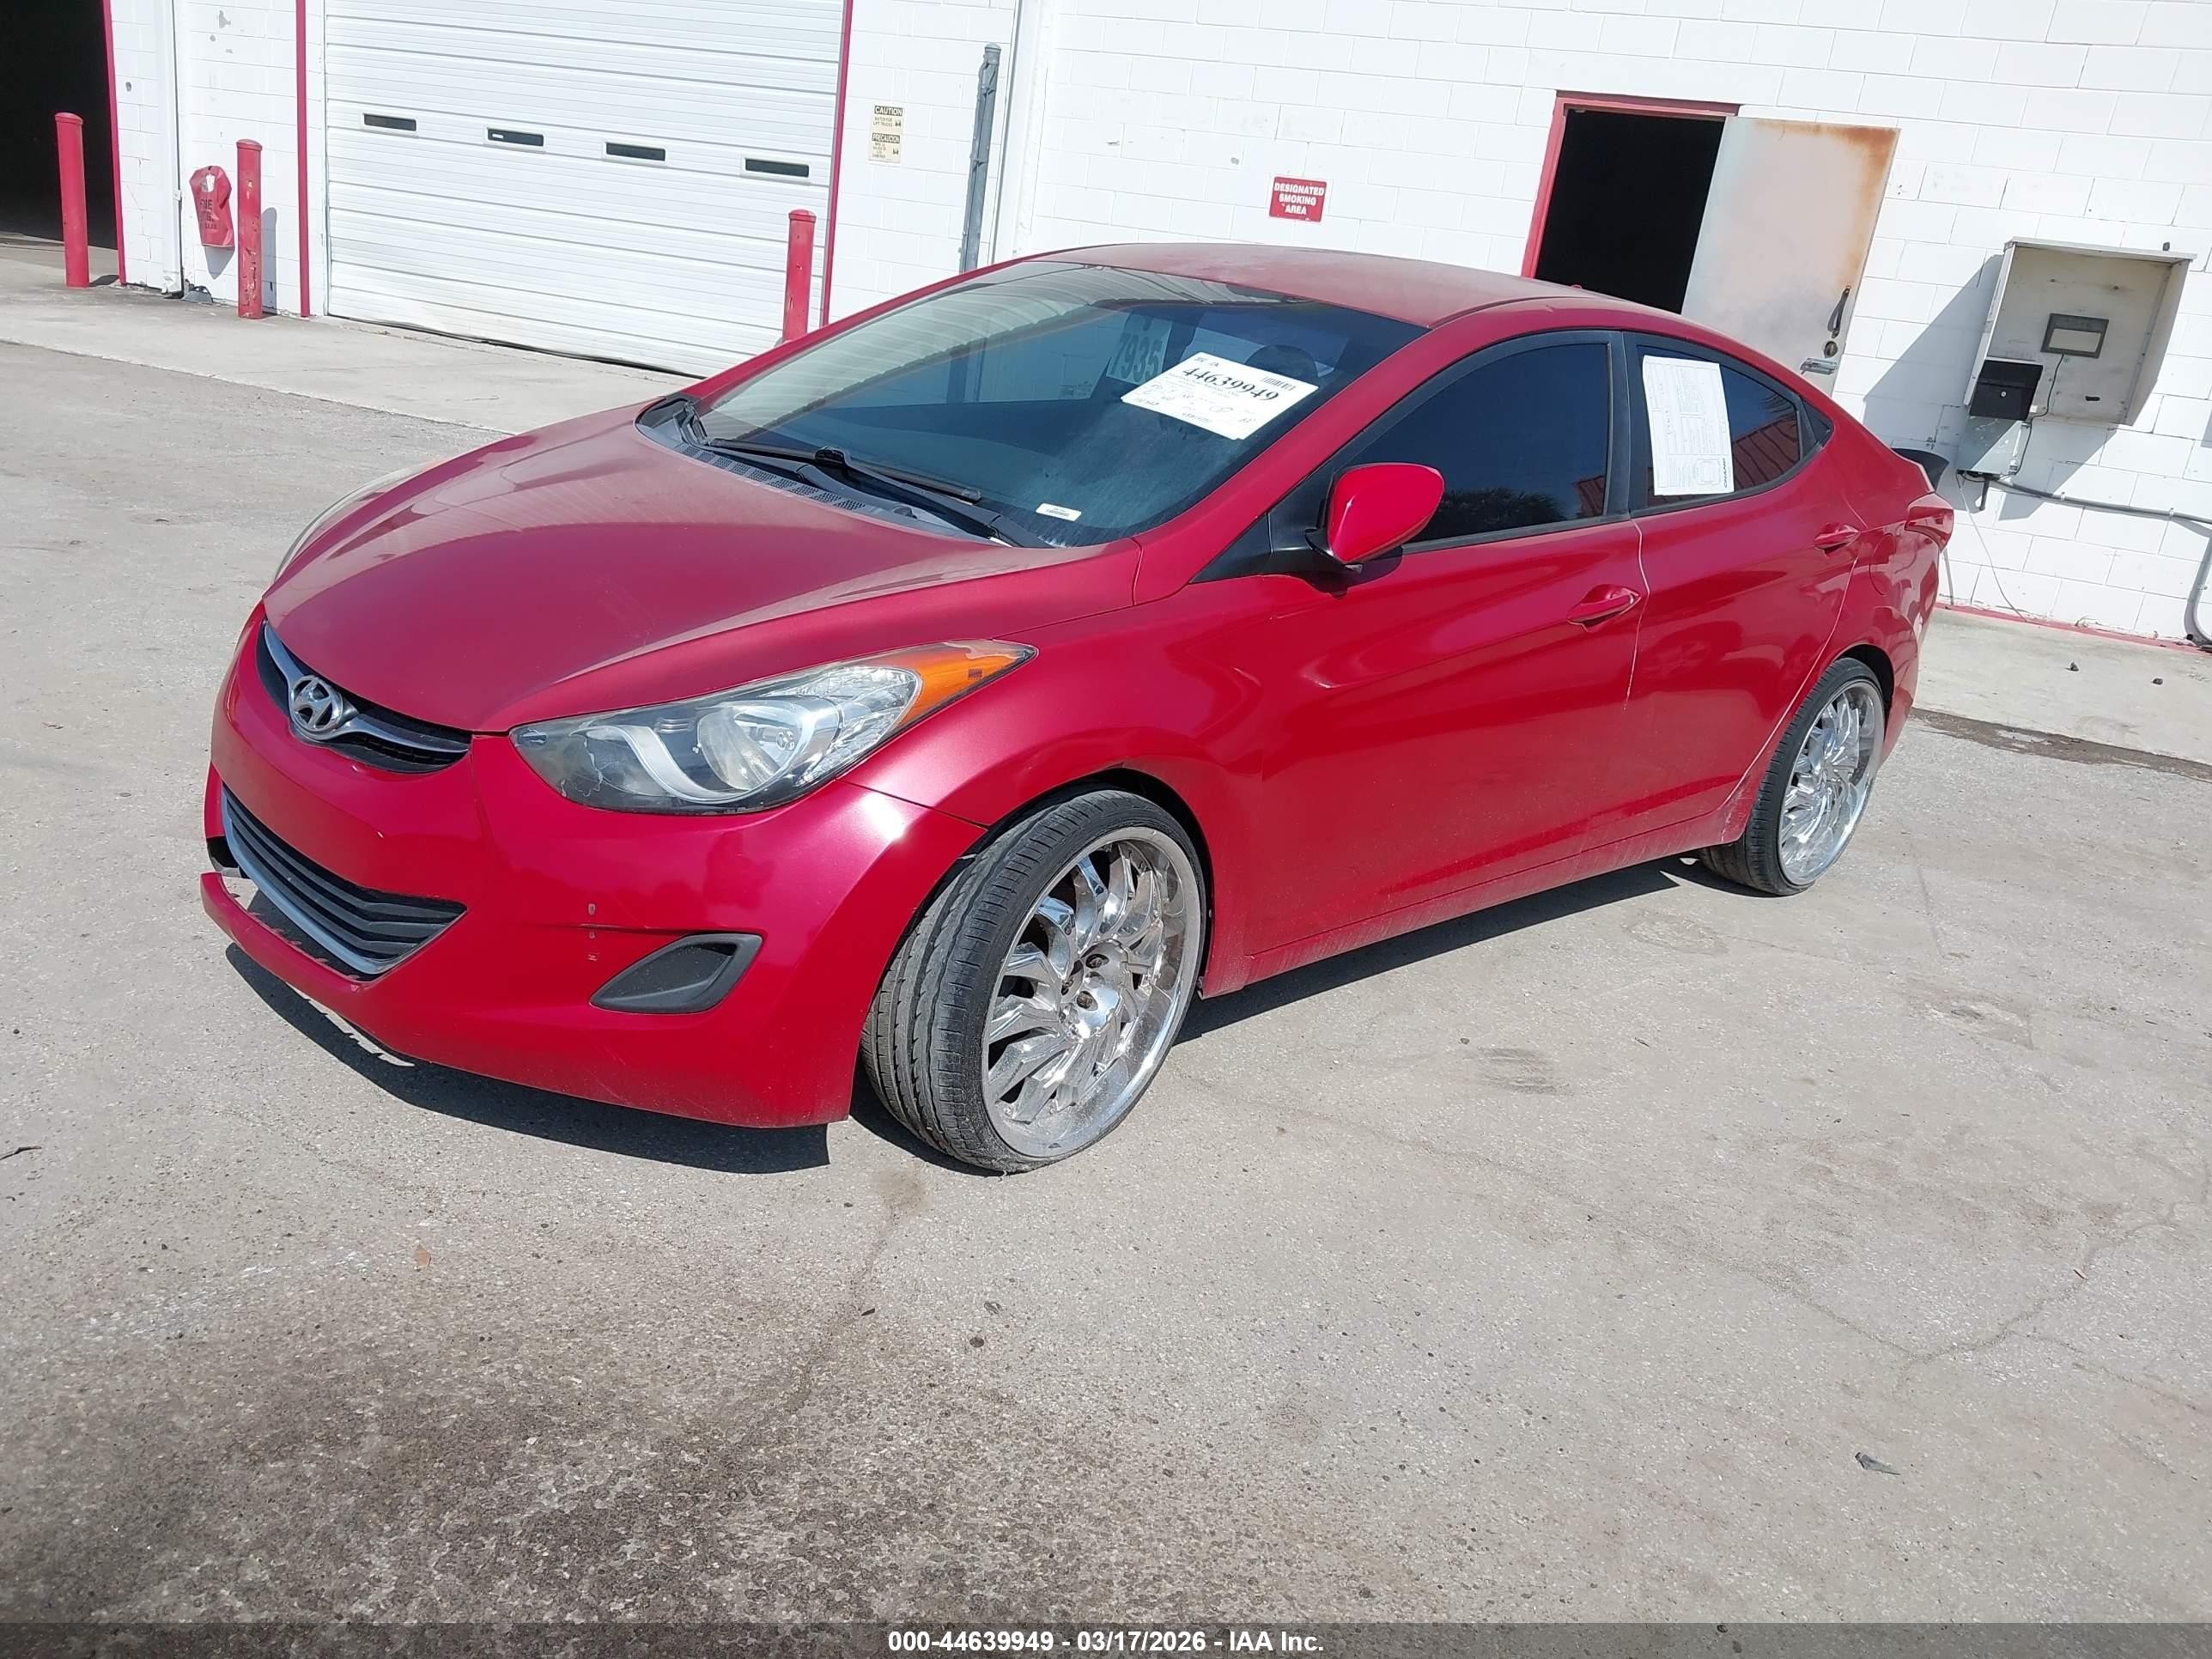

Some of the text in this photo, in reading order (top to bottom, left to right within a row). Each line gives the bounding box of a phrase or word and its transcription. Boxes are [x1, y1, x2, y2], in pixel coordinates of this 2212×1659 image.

[876, 106, 902, 116] CAUTION
[1274, 183, 1325, 196] DESIGNATED
[1279, 193, 1317, 206] SMOKING
[1285, 204, 1307, 215] AREA
[1110, 331, 1164, 380] 7935
[1182, 367, 1280, 401] 44639949
